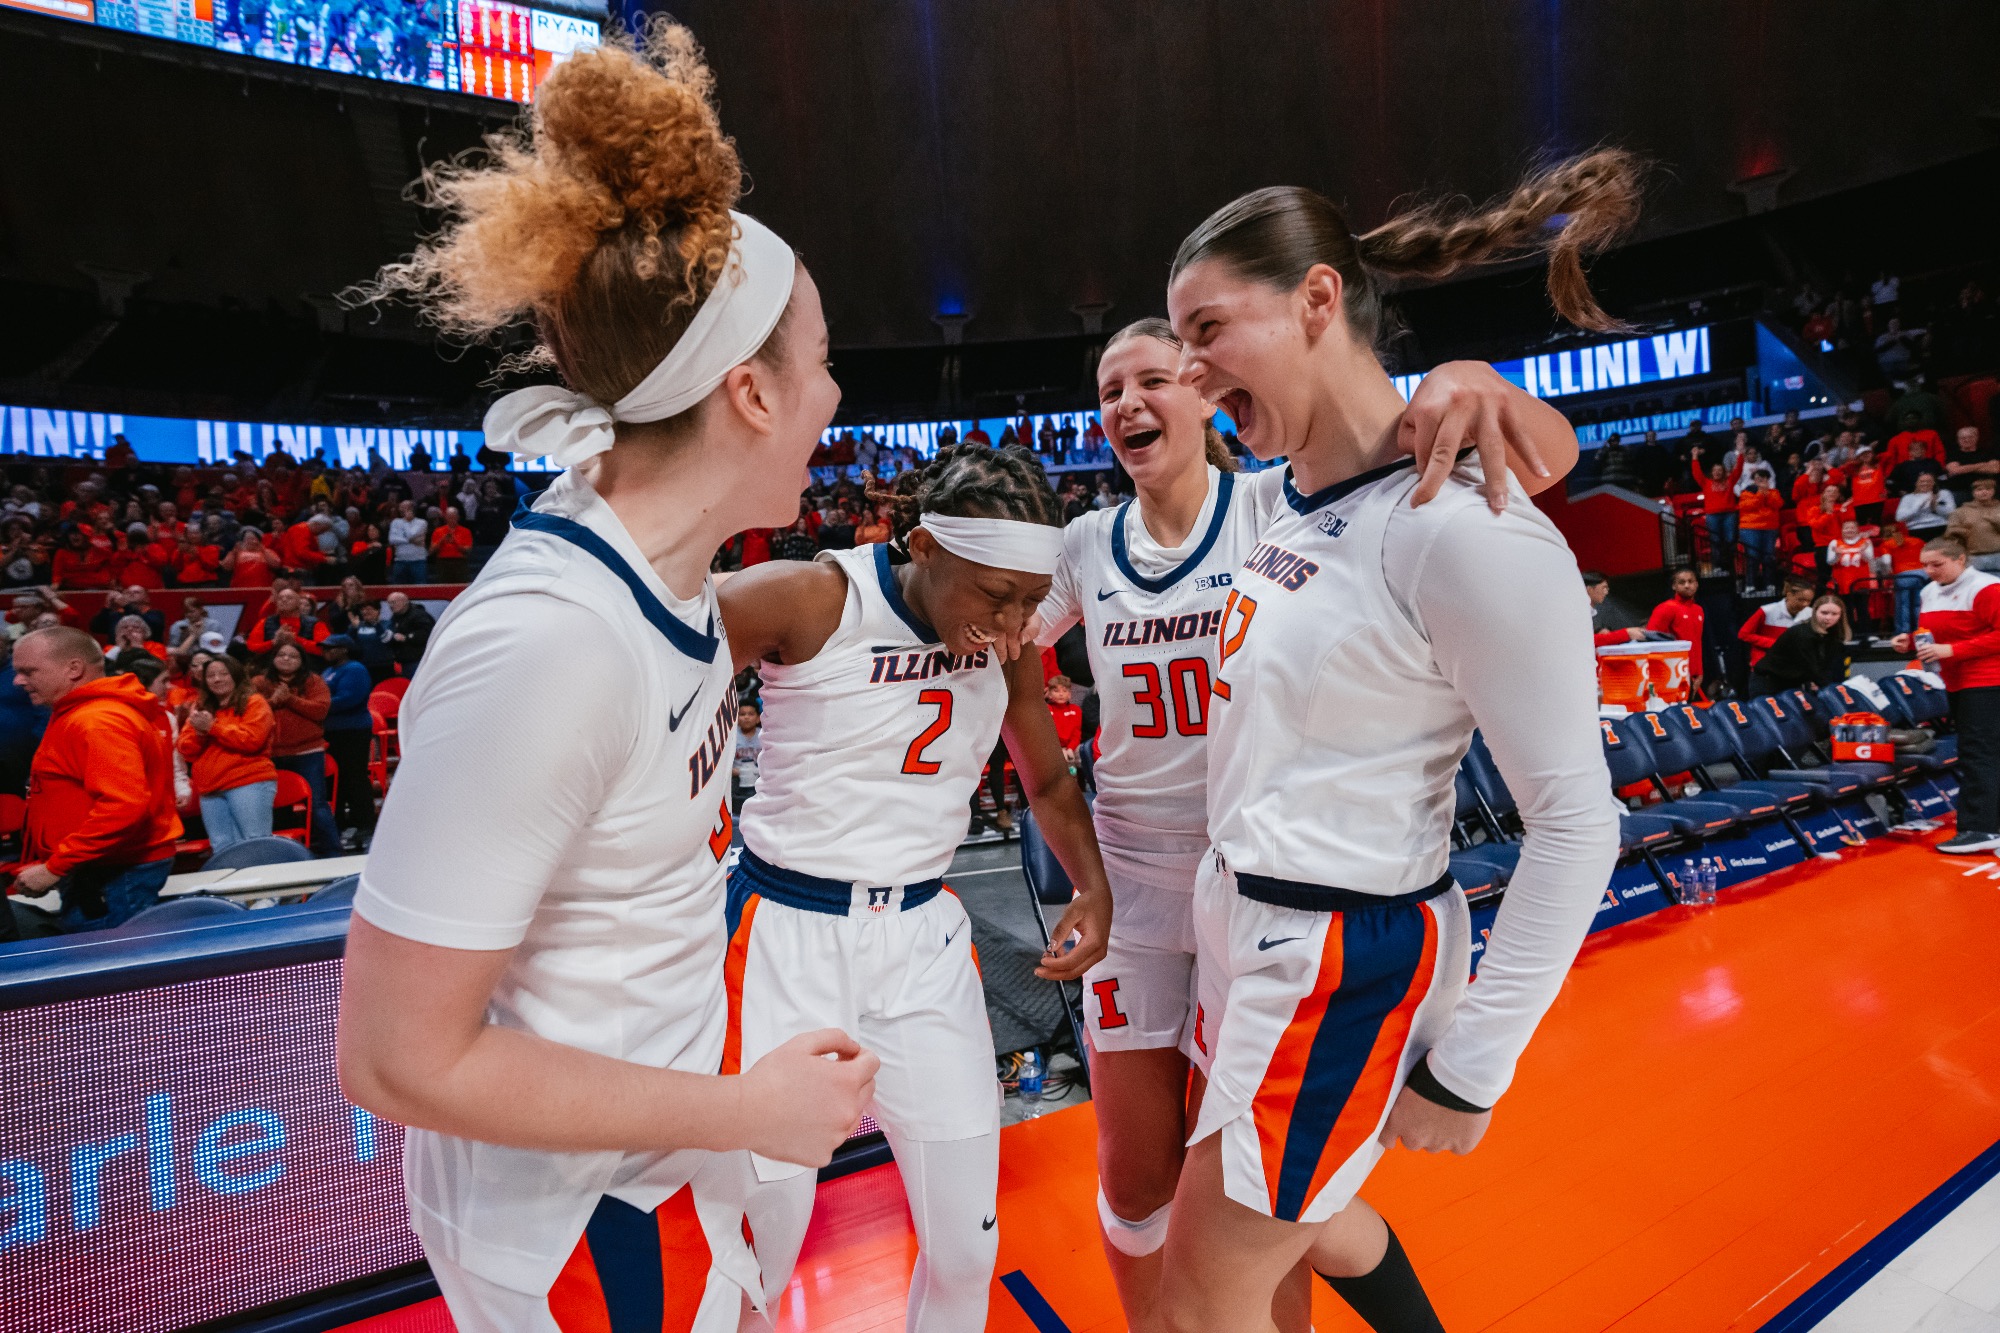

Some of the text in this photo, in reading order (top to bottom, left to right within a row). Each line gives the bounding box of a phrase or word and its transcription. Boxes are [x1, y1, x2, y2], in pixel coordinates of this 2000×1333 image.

[537, 14, 594, 38] RYAN
[1523, 338, 1641, 398] ILLINI
[0, 405, 124, 459] IN!!!
[1121, 656, 1212, 739] 30
[1728, 701, 1748, 724] I
[900, 688, 954, 775] 2
[1644, 713, 1667, 737] I
[1682, 706, 1703, 729] I
[1855, 745, 1872, 759] G
[1092, 977, 1129, 1030] I
